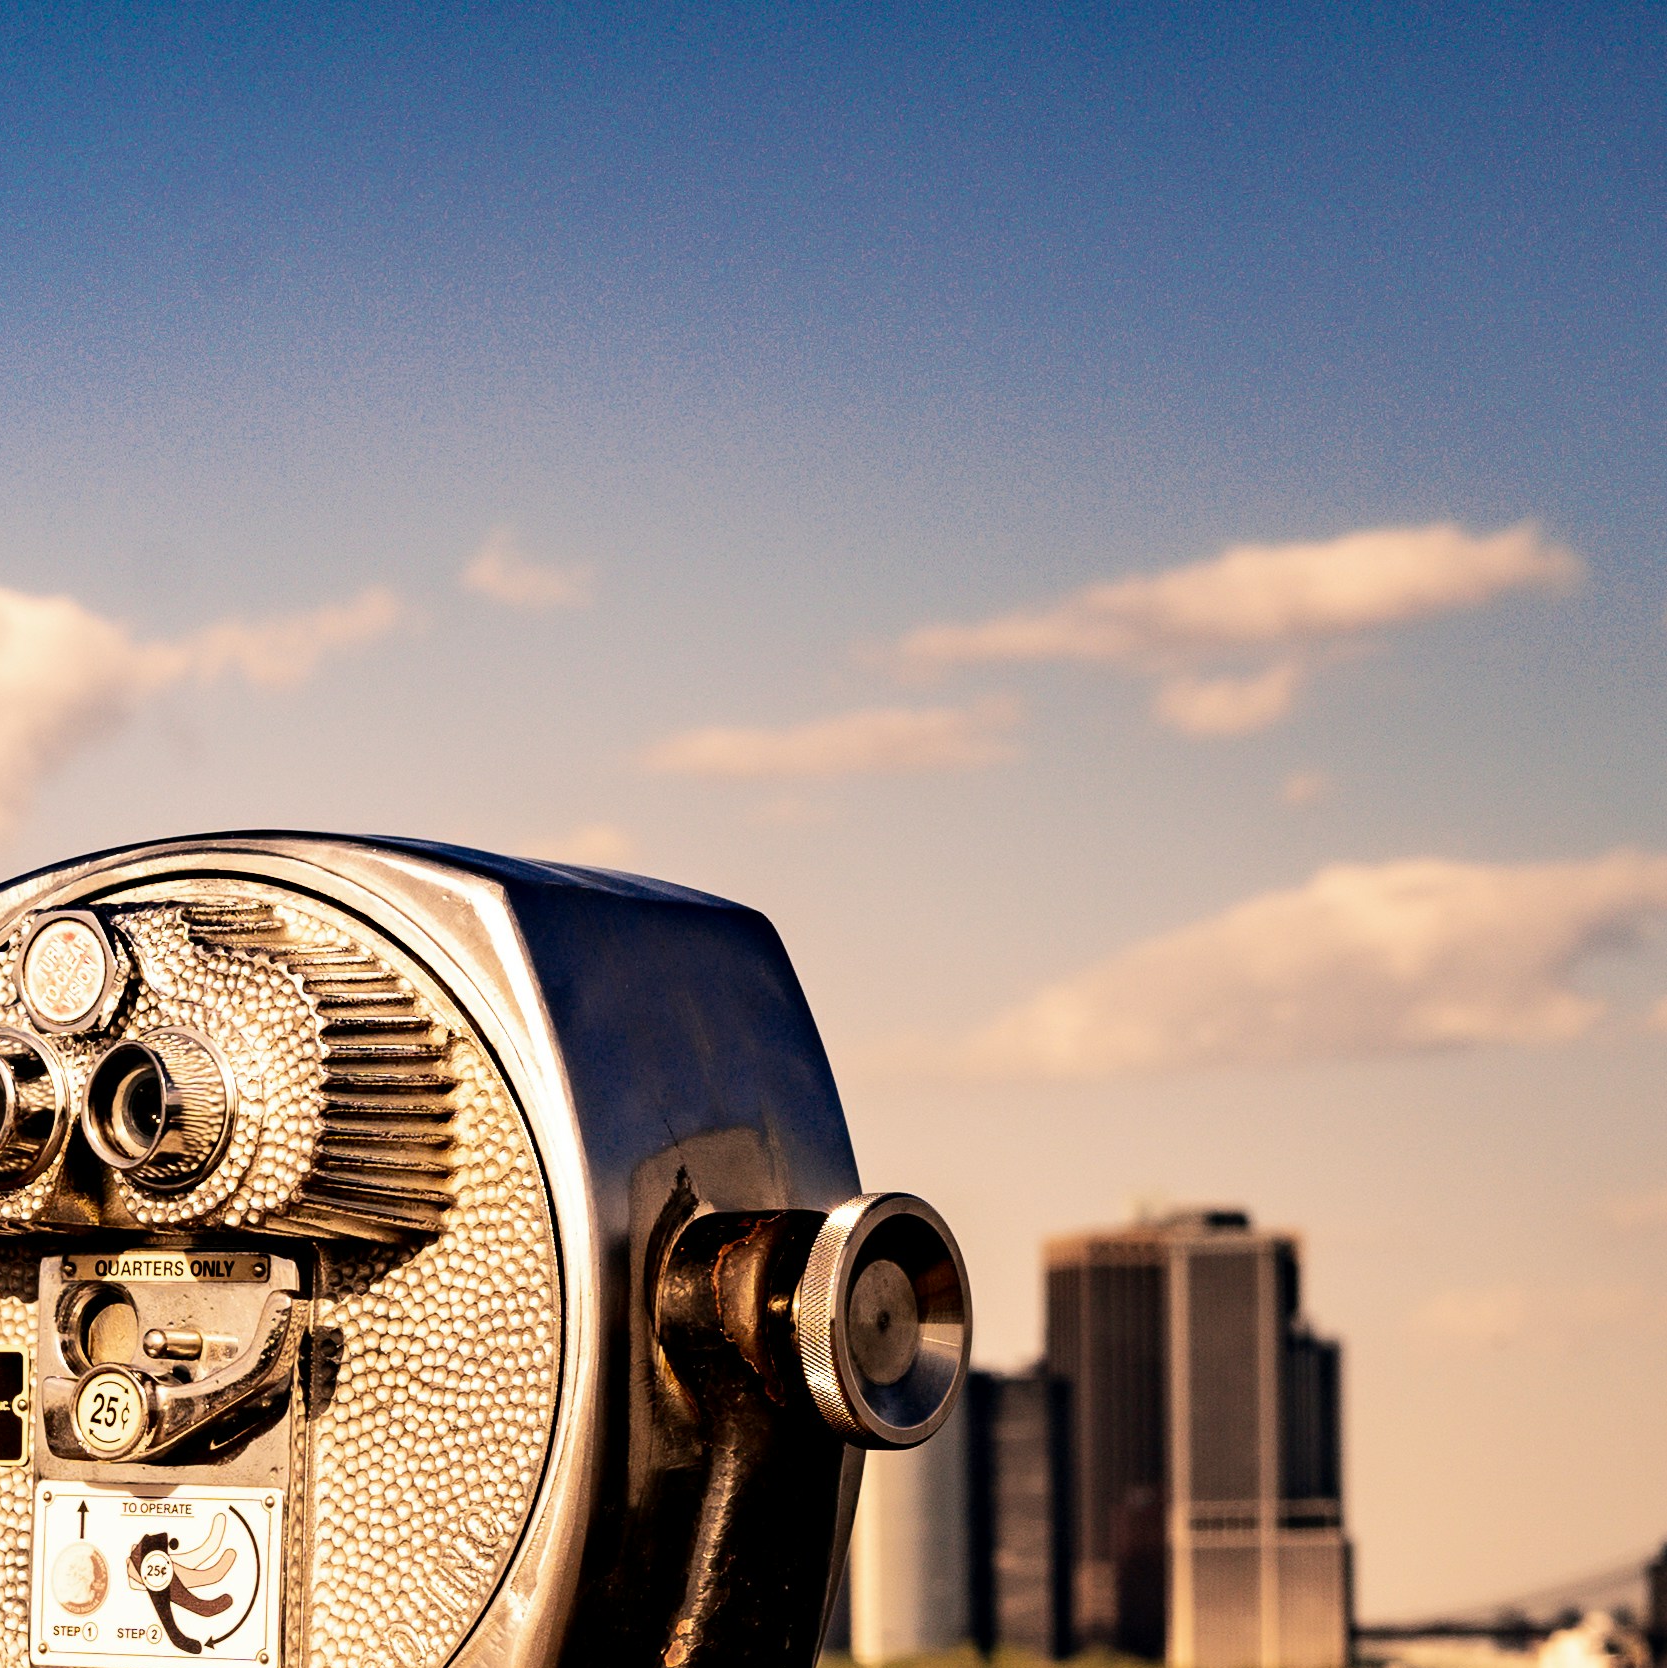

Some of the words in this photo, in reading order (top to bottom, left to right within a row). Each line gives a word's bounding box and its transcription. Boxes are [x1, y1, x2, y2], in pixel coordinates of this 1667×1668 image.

[35, 935, 67, 979] TURN
[40, 985, 60, 1008] TO
[54, 934, 90, 985] CLEAR
[61, 957, 99, 1009] VISION
[94, 1260, 184, 1277] QUARTERS
[190, 1260, 235, 1277] ONLY
[90, 1392, 130, 1430] 25¢
[122, 1502, 138, 1513] TO
[140, 1503, 193, 1515] OPERATE
[147, 1564, 167, 1578] 25¢
[53, 1626, 81, 1637] STEP
[117, 1628, 146, 1639] STEP
